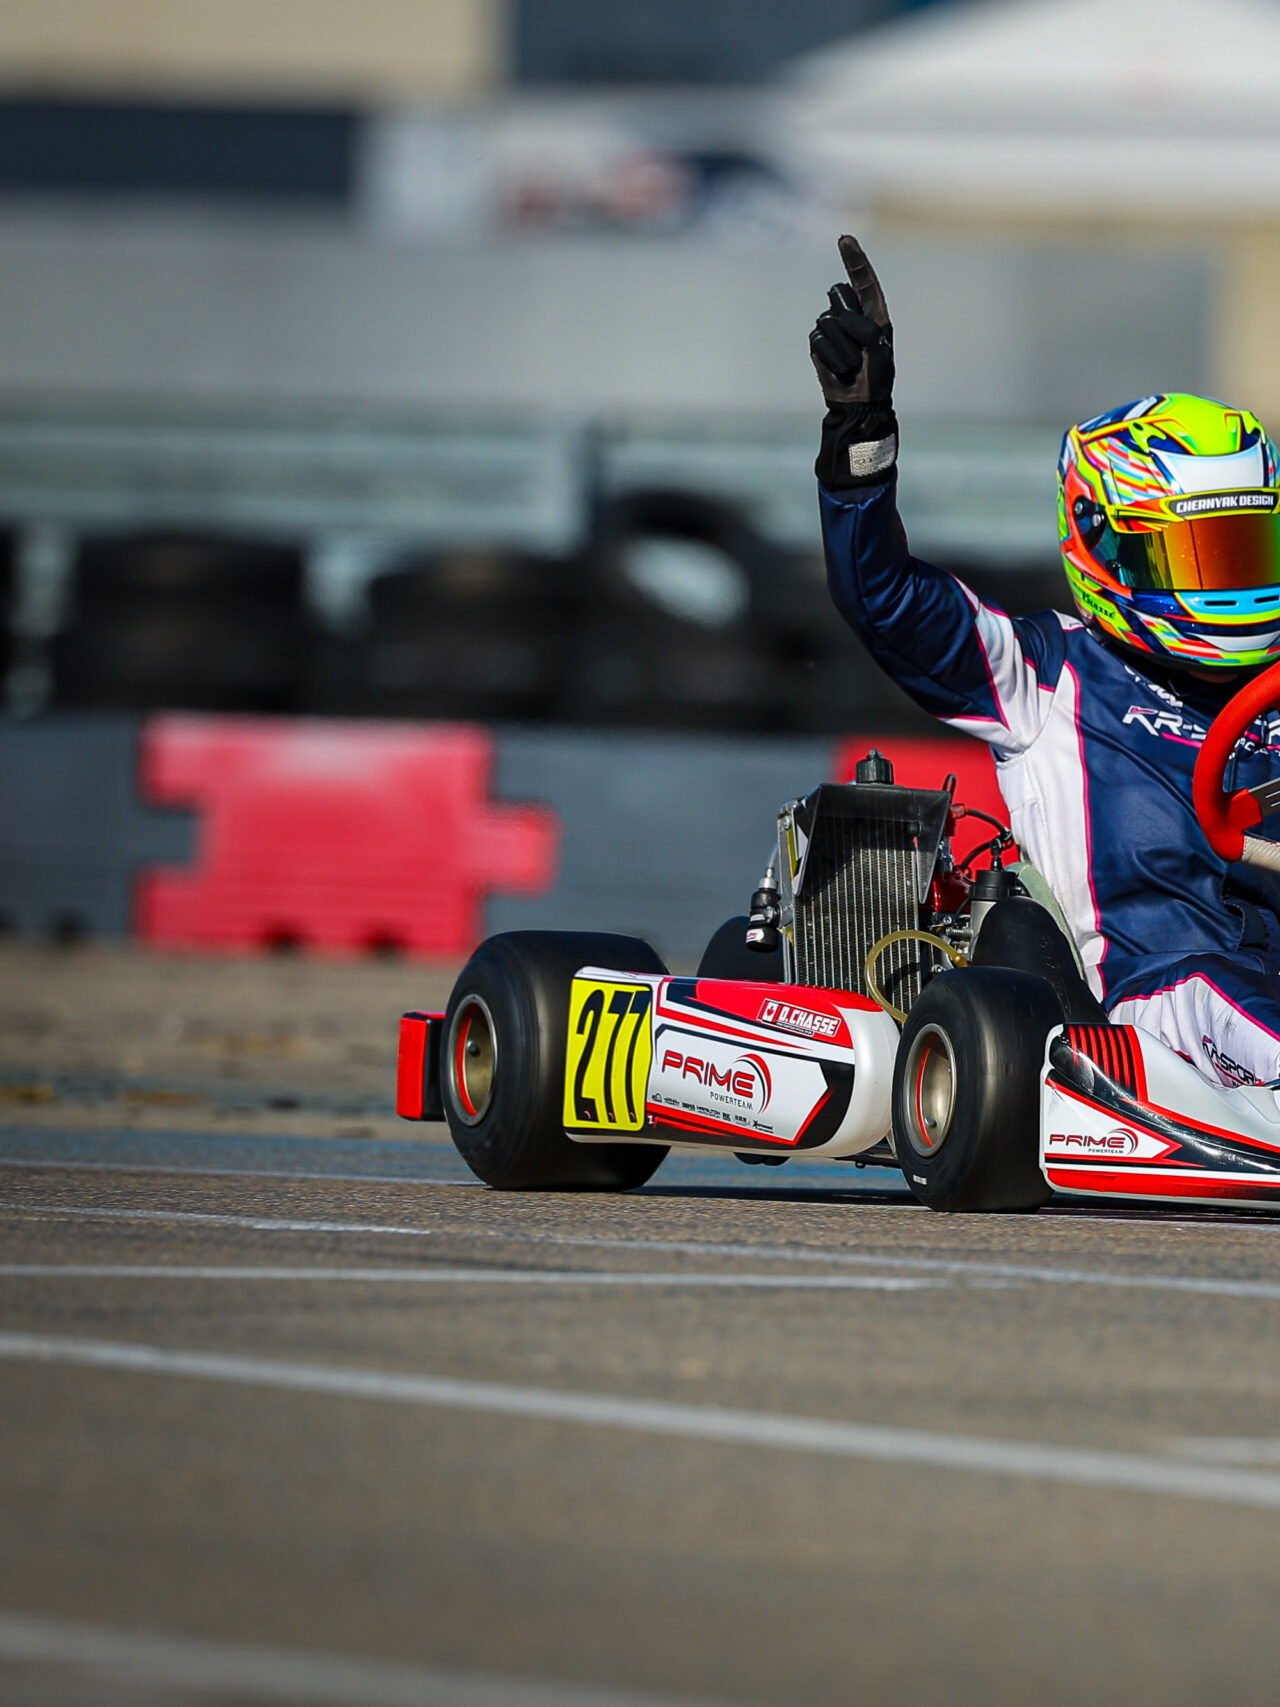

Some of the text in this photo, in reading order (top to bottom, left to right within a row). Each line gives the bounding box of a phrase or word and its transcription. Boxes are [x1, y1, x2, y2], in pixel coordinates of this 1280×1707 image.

[1176, 495, 1274, 513] CHERNYAK DESIGN
[574, 989, 654, 1124] 277
[661, 1049, 756, 1099] PRIME
[709, 1090, 754, 1111] POWERTEAM
[1048, 1133, 1126, 1149] PRIME
